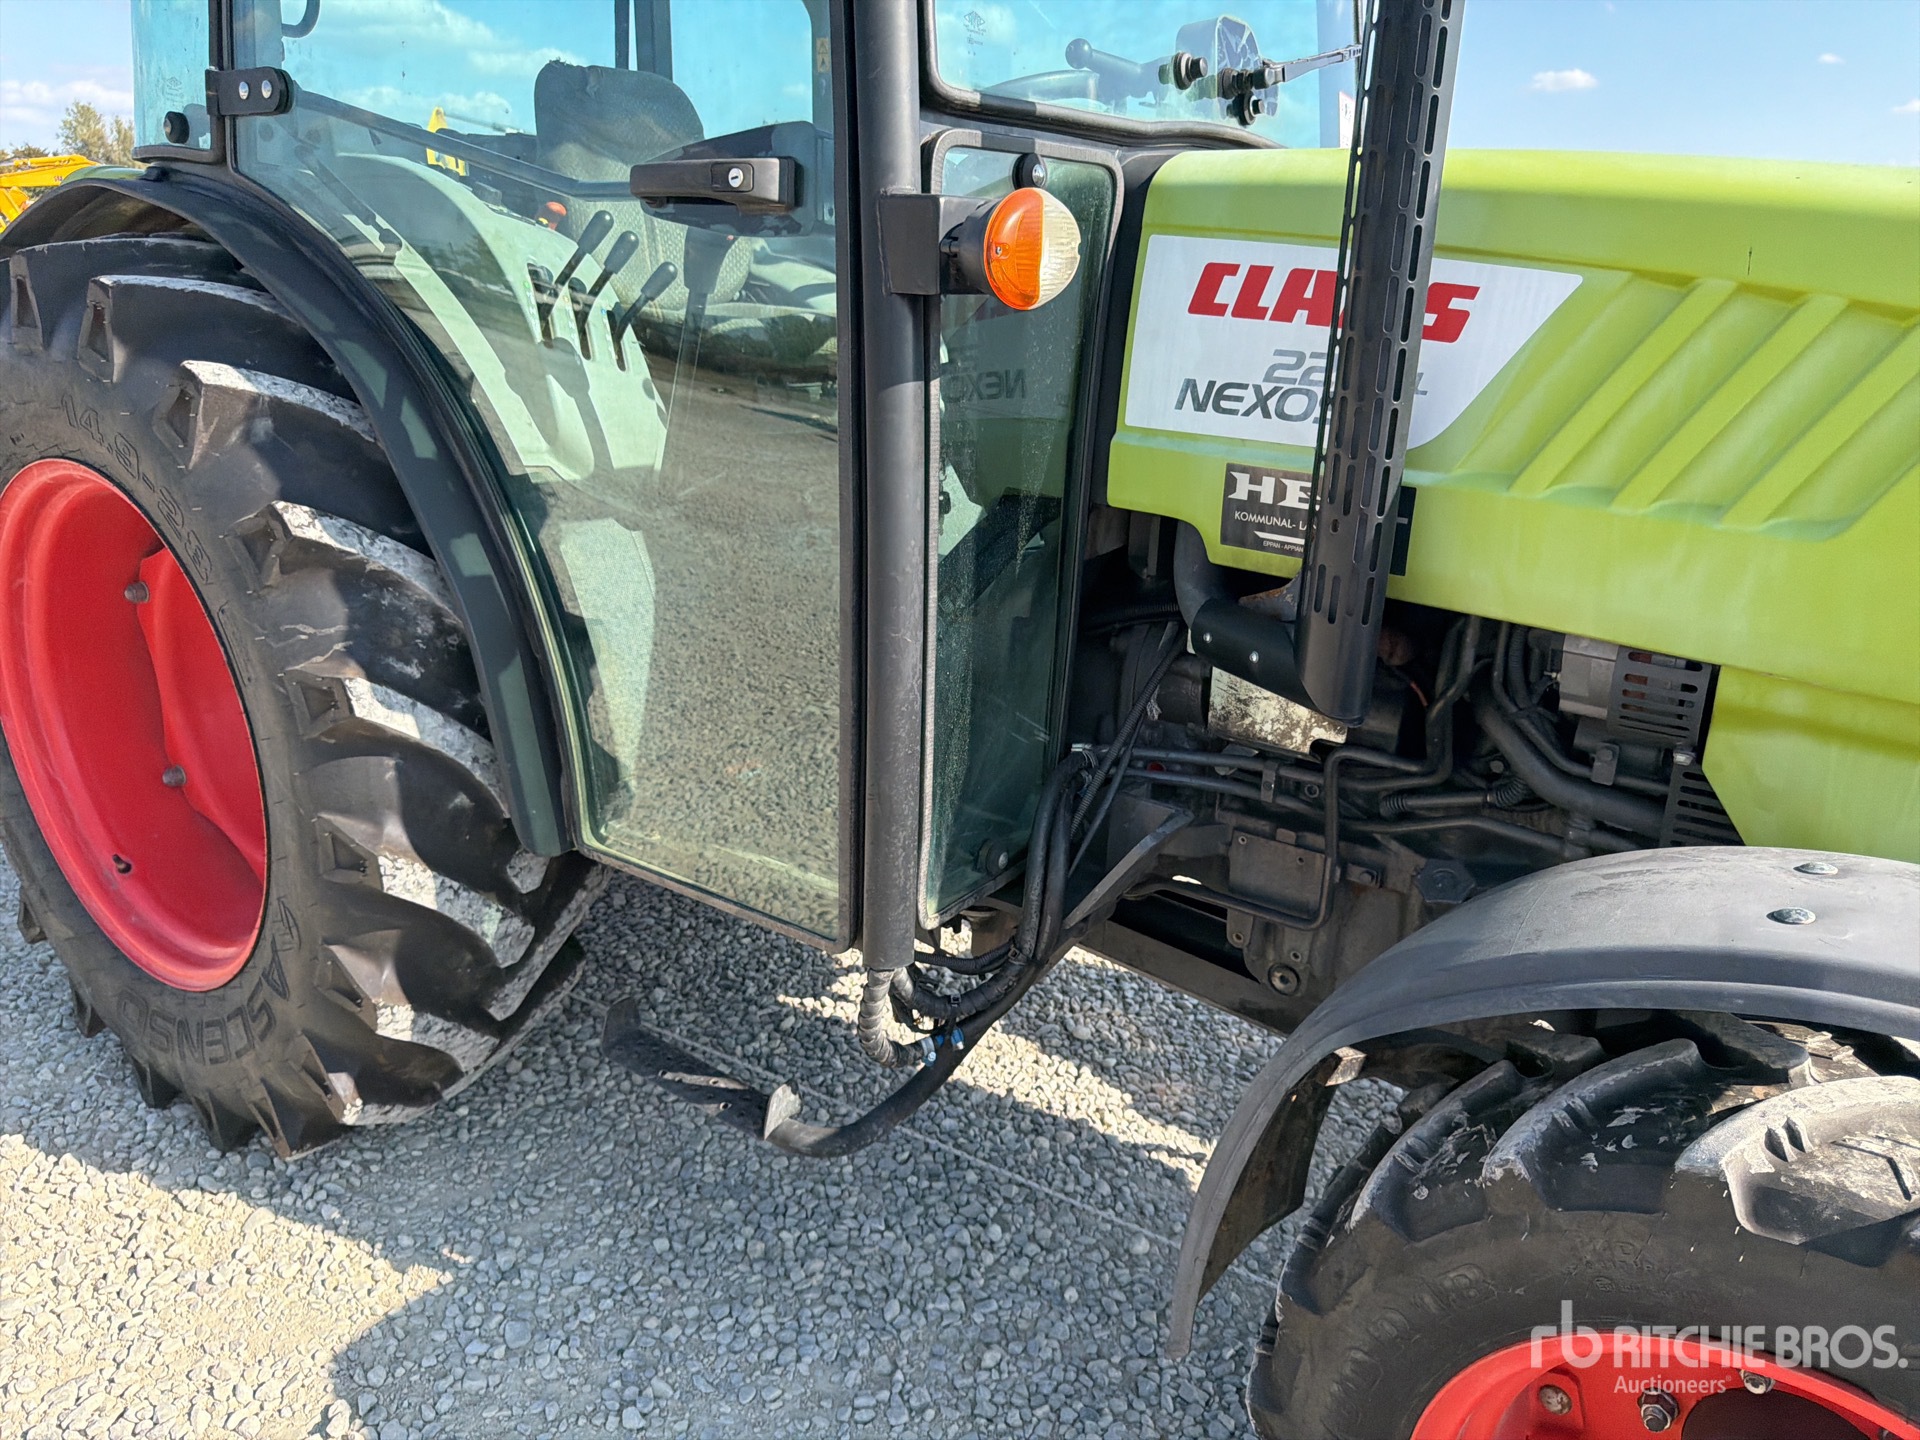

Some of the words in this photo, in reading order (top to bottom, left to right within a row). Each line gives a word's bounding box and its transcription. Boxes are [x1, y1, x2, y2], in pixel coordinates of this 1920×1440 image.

[1187, 261, 1481, 344] CLAS
[1262, 348, 1337, 387] 22
[1284, 543, 1304, 553] APPIAN
[117, 933, 291, 1066] ASCENSO
